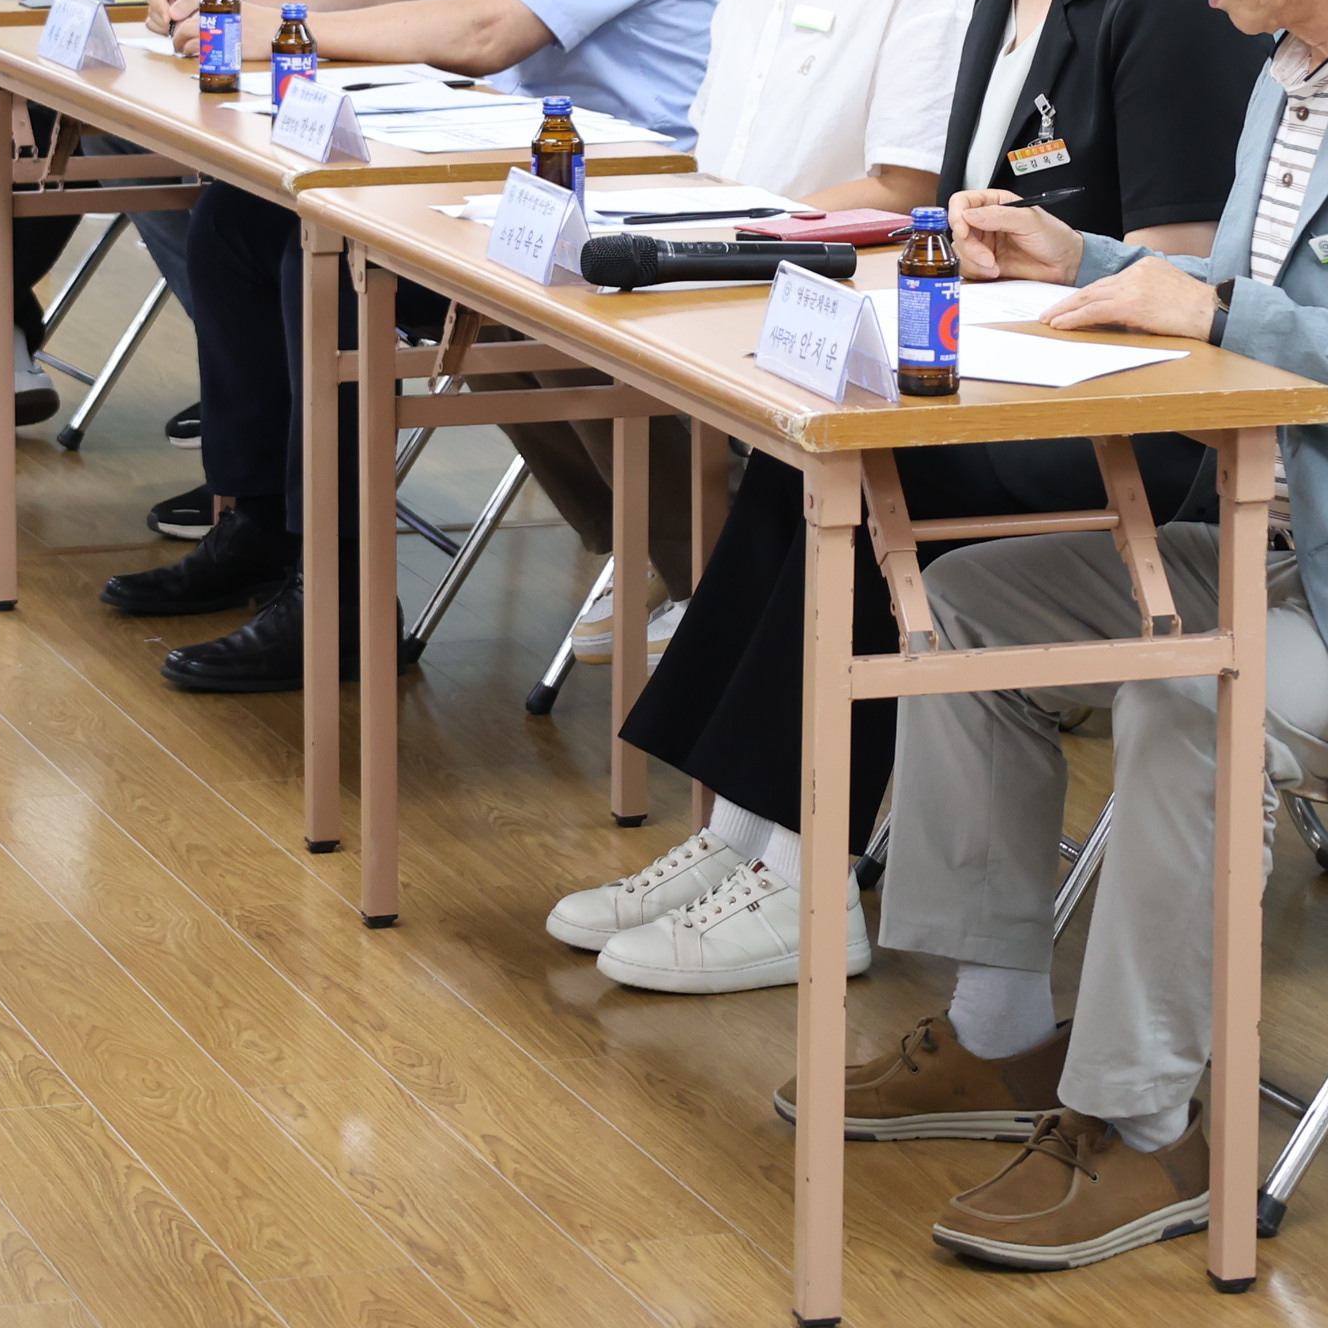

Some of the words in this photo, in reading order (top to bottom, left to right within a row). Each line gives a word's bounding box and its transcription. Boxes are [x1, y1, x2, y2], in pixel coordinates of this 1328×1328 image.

[1029, 153, 1064, 168] 김옥순
[500, 226, 514, 247] 소장
[514, 225, 544, 259] 김옥순
[796, 285, 839, 318] 영동군체육회
[770, 325, 797, 354] 사무국장
[799, 332, 839, 371] 안치운
